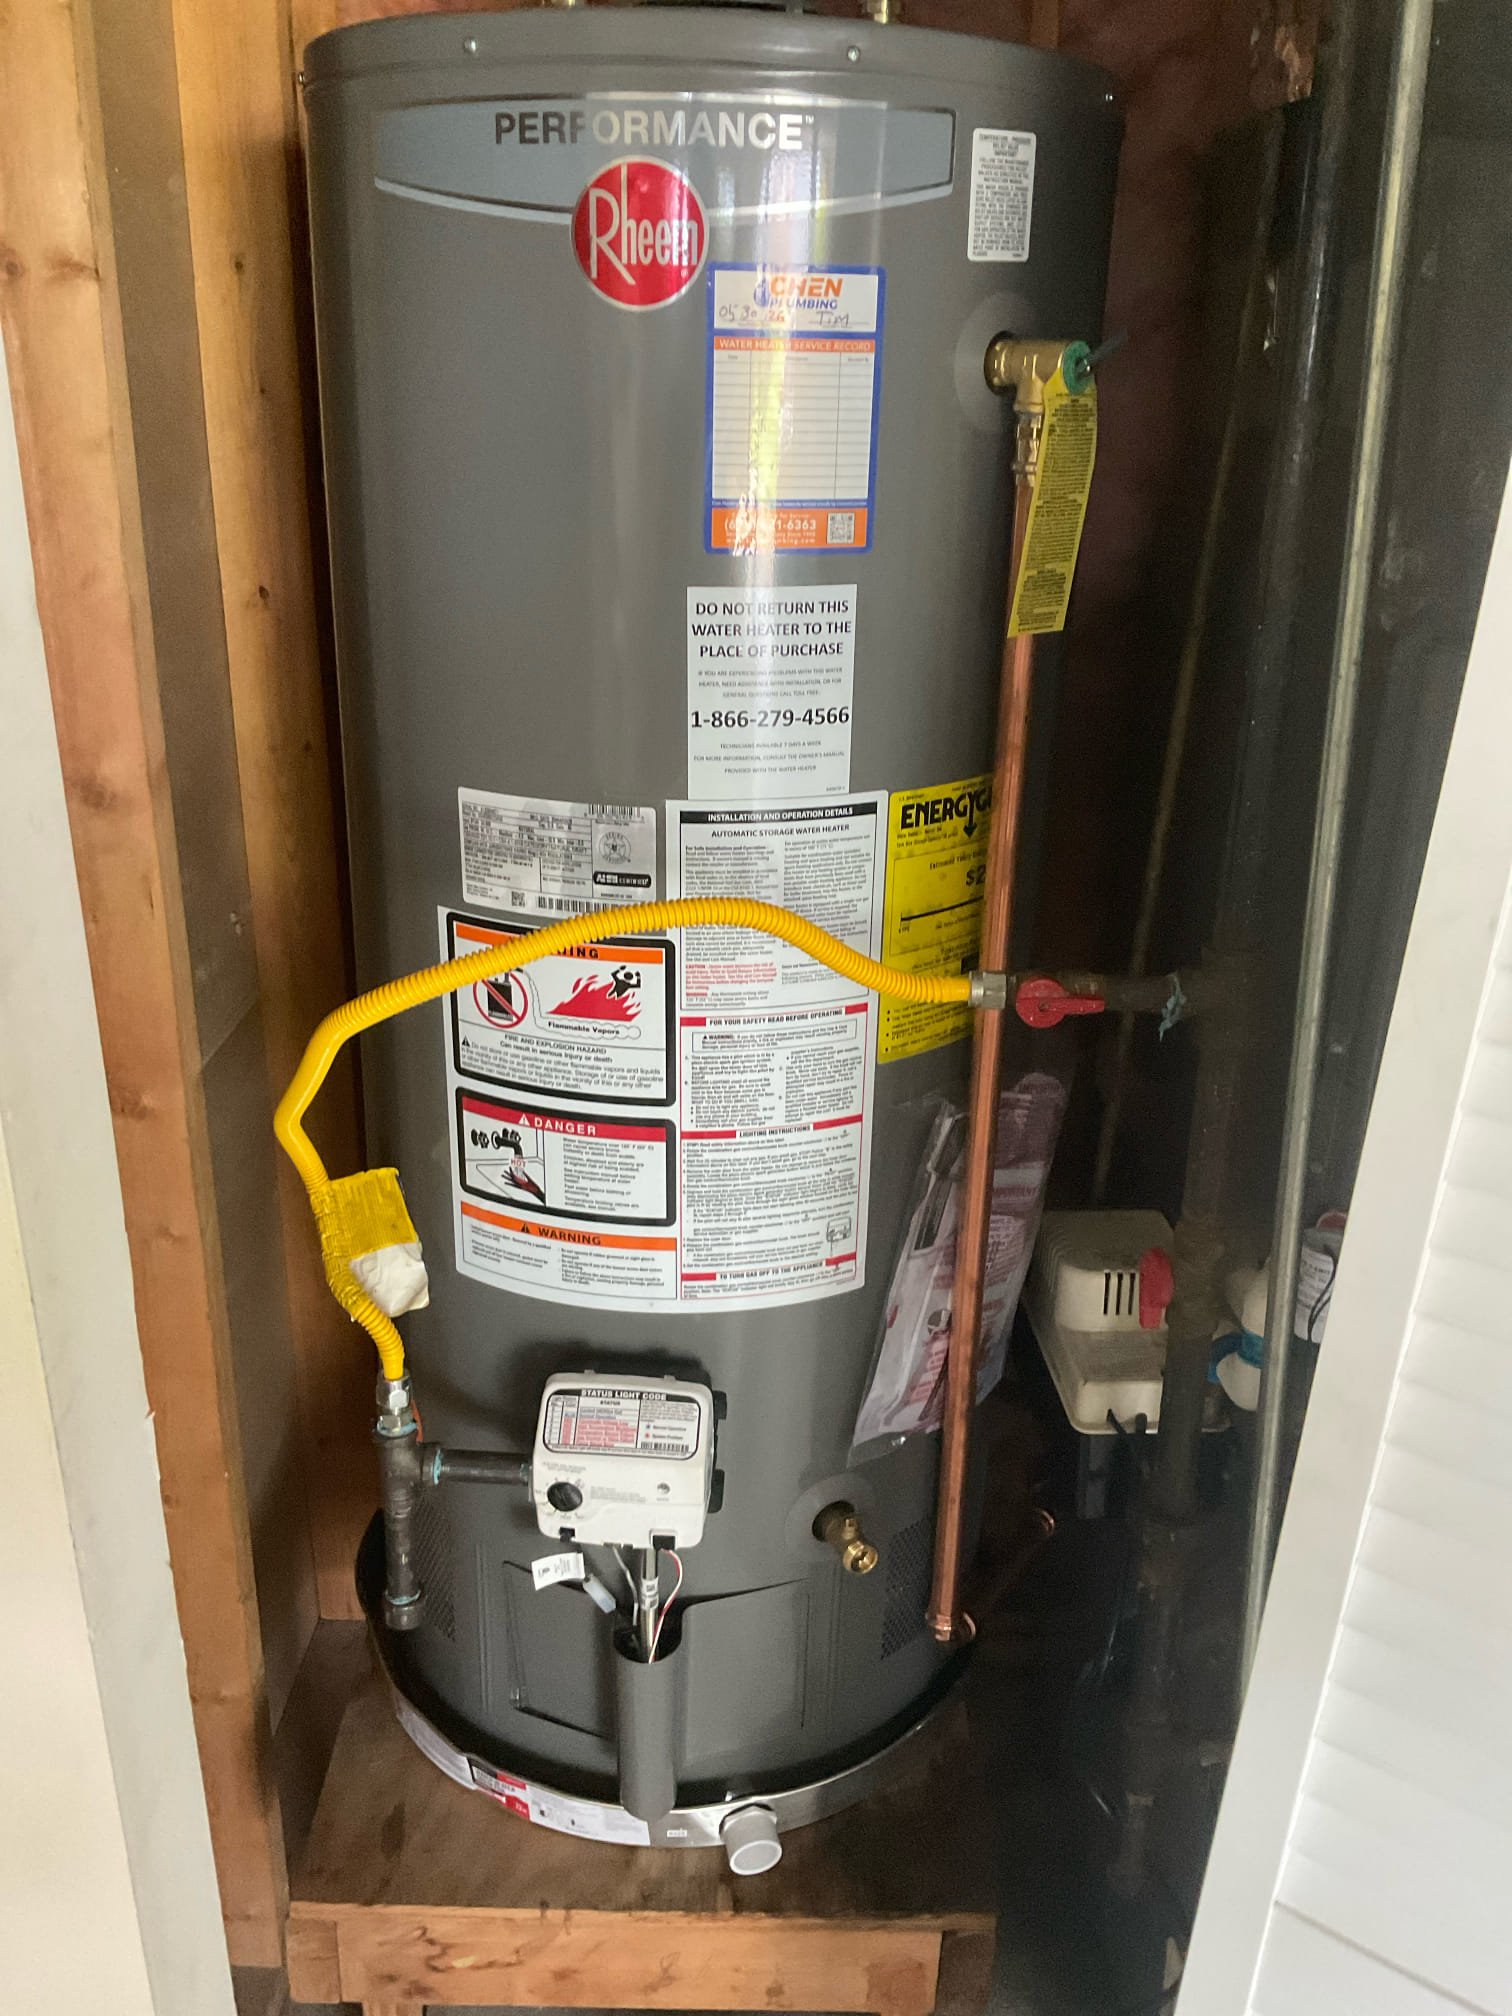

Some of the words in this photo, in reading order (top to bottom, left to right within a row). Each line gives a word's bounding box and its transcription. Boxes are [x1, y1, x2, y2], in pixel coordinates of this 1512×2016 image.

[588, 164, 698, 285] Rheem
[770, 276, 843, 298] CHEN
[770, 299, 838, 310] PLUMBING
[719, 339, 753, 350] WATER
[794, 341, 831, 351] SERVICE
[833, 341, 870, 352] RECORD
[695, 602, 718, 616] DO
[722, 602, 751, 616] NOT
[757, 601, 815, 615] RETURN
[818, 600, 849, 613] THIS
[691, 623, 742, 637] WATER
[746, 623, 800, 636] HEATER
[803, 622, 822, 635] TO
[825, 621, 852, 634] THE
[699, 645, 743, 658] PLACE
[747, 644, 767, 657] OF
[771, 642, 844, 657] PURCHASE
[690, 706, 850, 728] 1-866-279-4566
[708, 813, 762, 823] INSTALLATION
[763, 812, 781, 821] AND
[782, 809, 824, 821] OPERATION
[825, 807, 854, 817] DETAILS
[711, 829, 757, 838] AUTOMATIC
[759, 828, 794, 837] STORAGE
[795, 826, 821, 835] WATER
[822, 823, 850, 833] HEATER
[742, 1017, 766, 1025] SAFETY
[767, 1015, 784, 1023] READ
[785, 1013, 809, 1022] BEFORE
[810, 1009, 843, 1020] OPERATING
[547, 1021, 590, 1033] Flammable
[592, 1026, 620, 1036] Vapors
[500, 1040, 513, 1049] Can
[504, 1034, 519, 1043] FIRE
[520, 1036, 535, 1045] AND
[535, 1038, 575, 1051] EXPLOSION
[576, 1045, 607, 1054] HAZARD
[534, 1116, 597, 1136] DANGER
[739, 1130, 767, 1138] LIGHTING
[768, 1125, 811, 1137] INSTRUCTIONS
[510, 1158, 527, 1167] HOT
[538, 1226, 601, 1246] WARNING
[581, 1389, 613, 1398] STATUS
[614, 1390, 641, 1400] LIGHT
[642, 1391, 667, 1401] CODE
